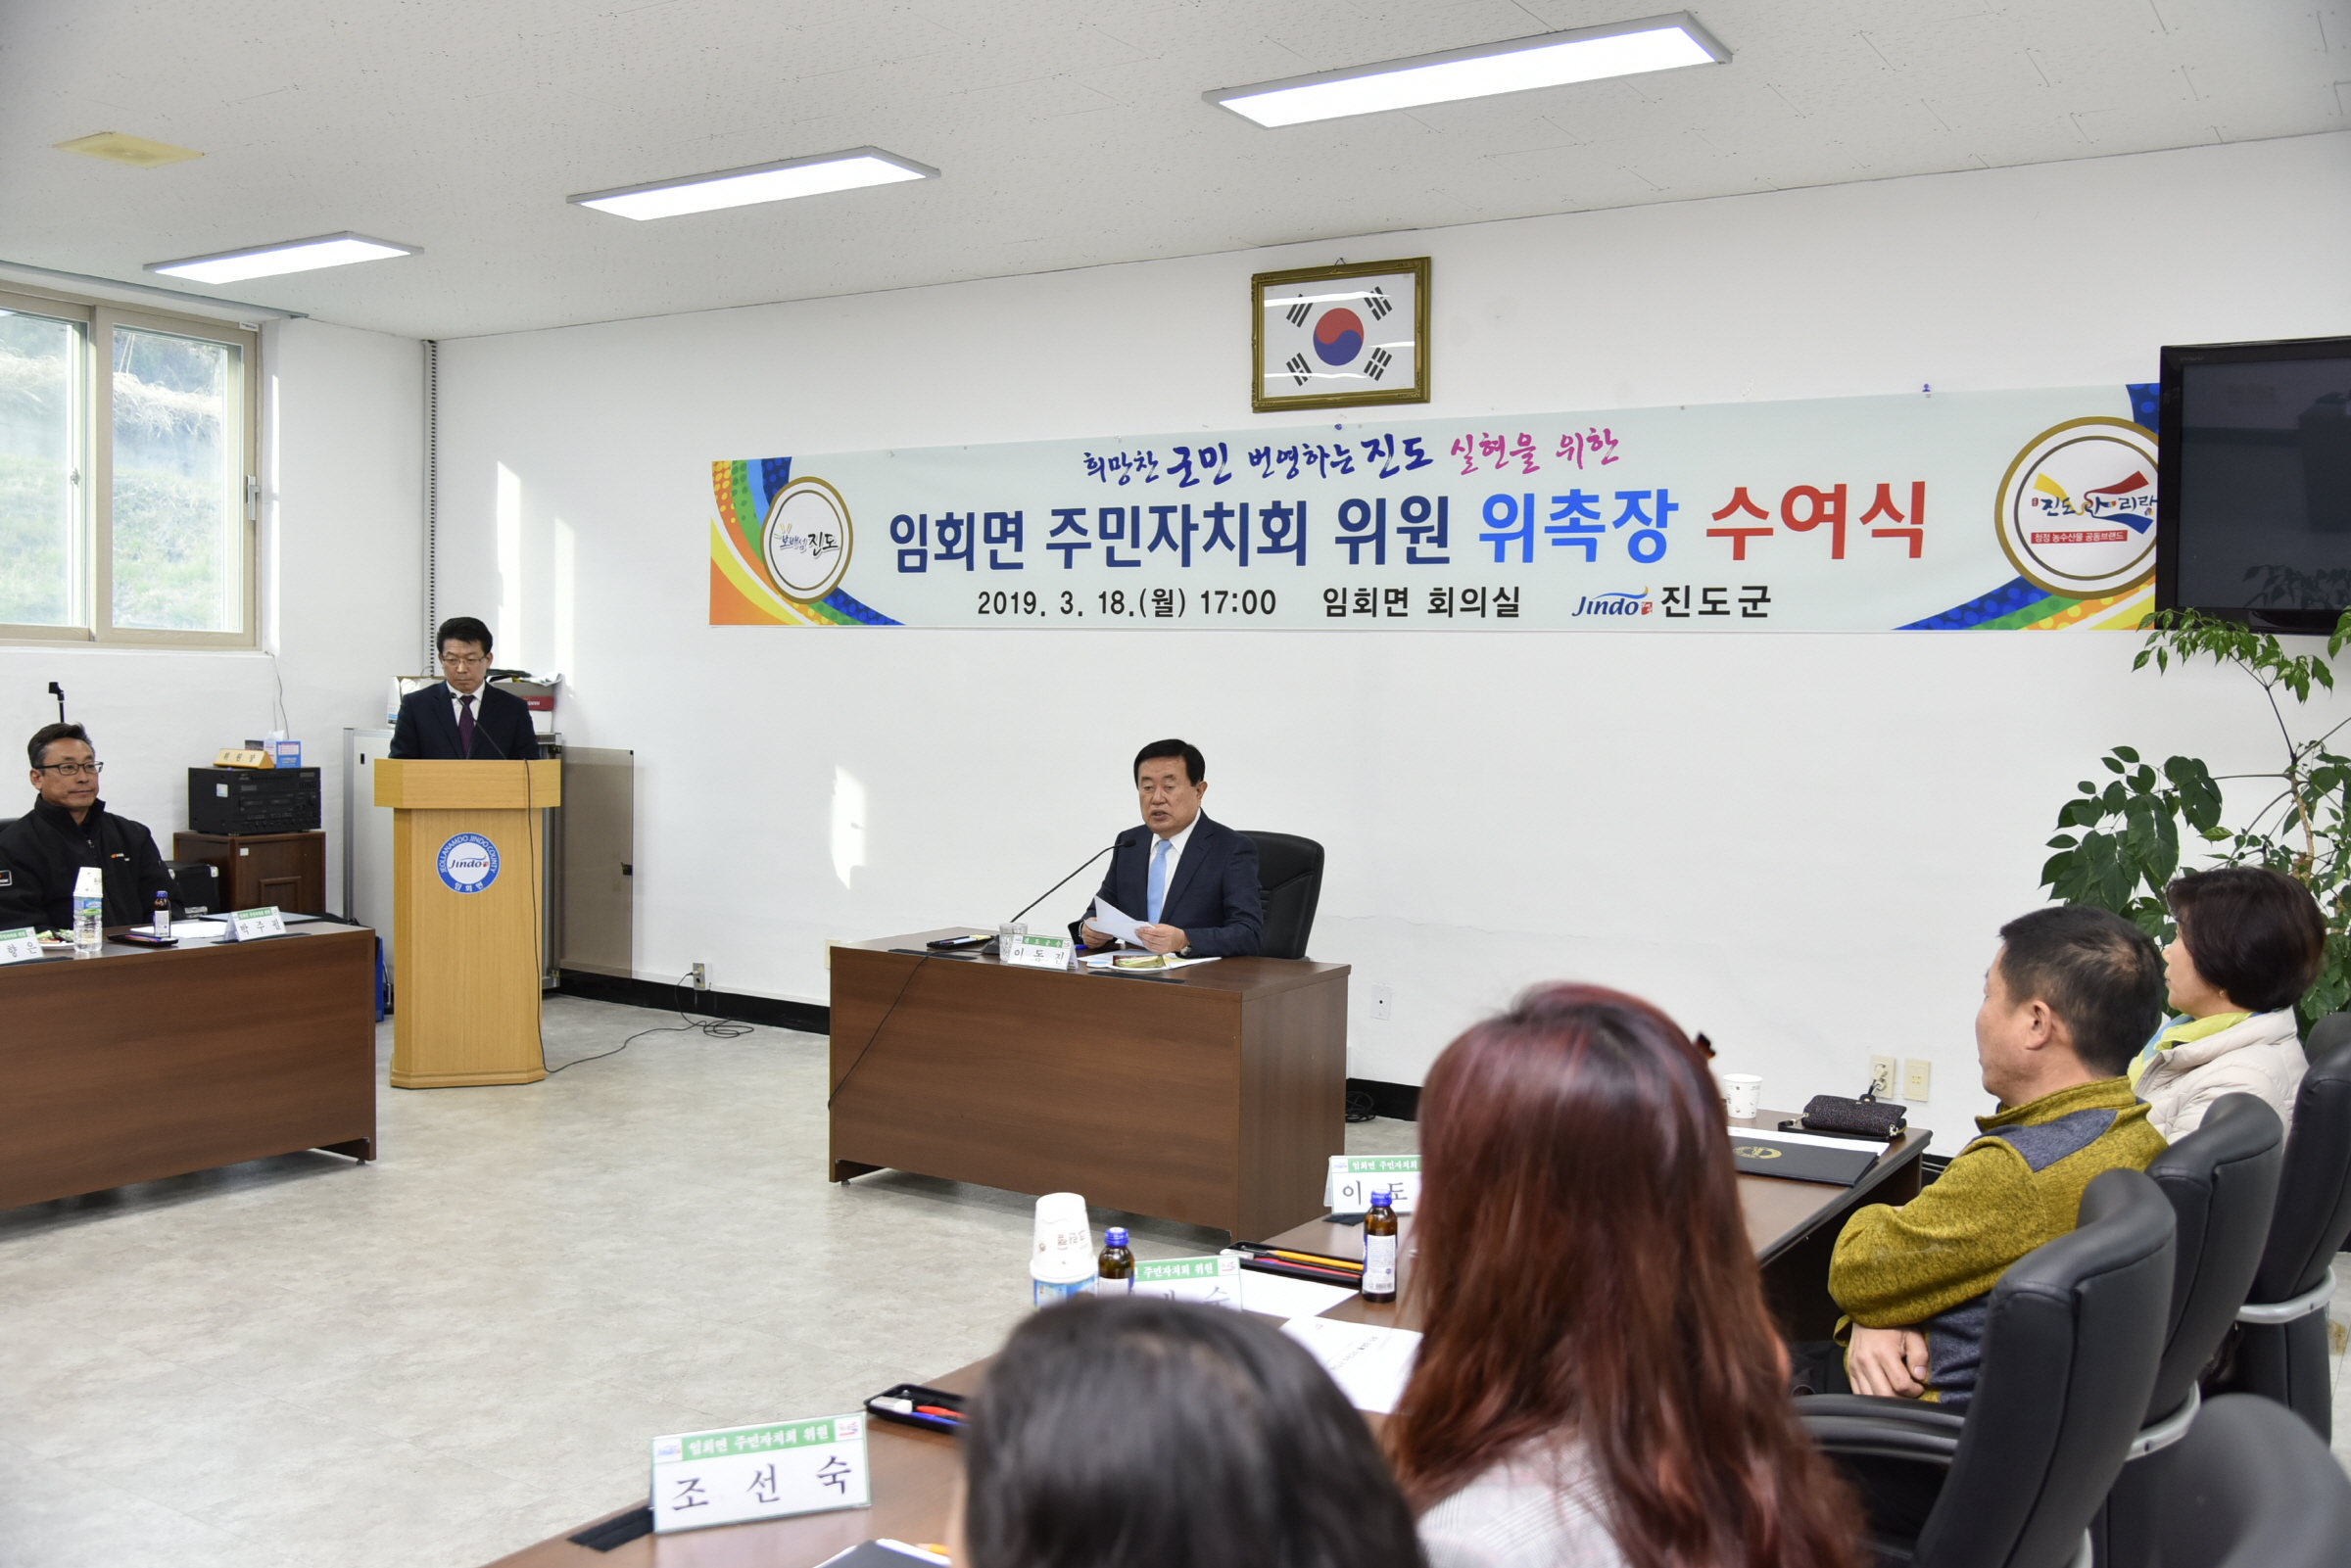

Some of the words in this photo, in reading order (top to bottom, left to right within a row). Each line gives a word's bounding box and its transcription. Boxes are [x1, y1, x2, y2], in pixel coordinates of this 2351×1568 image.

[1083, 451, 1159, 486] 희망찬
[1167, 442, 1232, 488] 군민
[1248, 443, 1356, 480] 번영하는
[1361, 433, 1434, 479] 진도
[1451, 432, 1540, 475] 실현을
[1556, 427, 1619, 470] 위한
[889, 510, 1025, 573] 임회면
[1045, 499, 1308, 570] 주민자치회
[1334, 495, 1451, 565] 위원
[1479, 488, 1680, 563] 위촉장
[1705, 480, 1926, 561] 수여식
[2035, 532, 2051, 543] 청정
[2052, 532, 2084, 543] 농수산물
[2086, 531, 2125, 542] 공동브랜드
[808, 532, 839, 556] 진도
[978, 591, 1045, 617] 2019.
[1060, 591, 1083, 617] 3.
[1098, 588, 1186, 618] 18.(월)
[1200, 590, 1277, 615] 17:00
[1322, 587, 1409, 617] 임회면
[1427, 586, 1520, 618] 회의실
[1571, 595, 1640, 617] Jindo
[1660, 585, 1772, 618] 진도군
[439, 834, 469, 874] JEOLLANAMDO
[469, 834, 489, 848] JINDO
[487, 845, 498, 874] COUNTY
[449, 859, 482, 869] Jindo
[1352, 1161, 1376, 1170] 임회면
[1379, 1161, 1417, 1170] 주민자치회
[1144, 1261, 1190, 1278] 주민자치회
[1194, 1261, 1214, 1275] 위원
[689, 1438, 728, 1456] 임회면
[735, 1429, 797, 1449] 주민자치회
[803, 1424, 829, 1442] 위원
